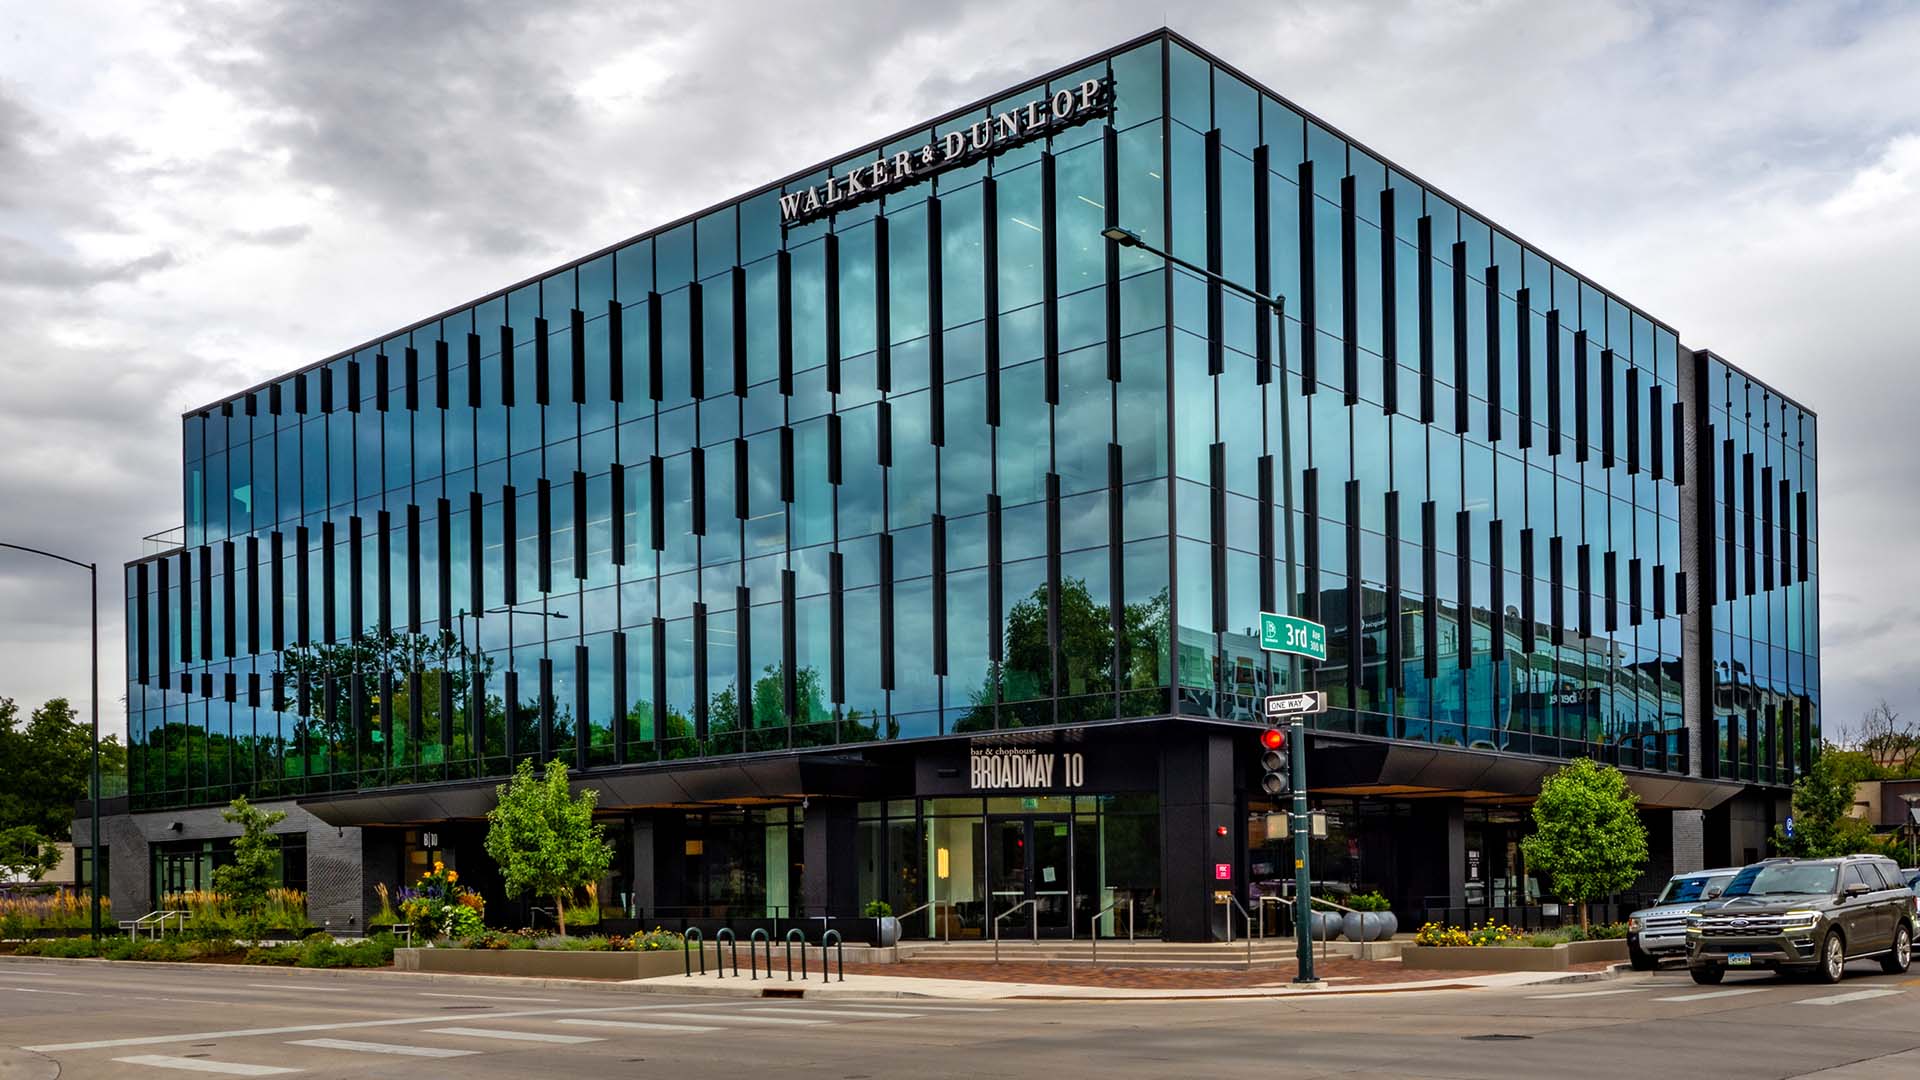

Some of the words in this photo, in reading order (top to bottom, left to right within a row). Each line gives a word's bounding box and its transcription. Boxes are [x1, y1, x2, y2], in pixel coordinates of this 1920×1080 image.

[778, 150, 912, 220] WALKER
[921, 144, 935, 164] &
[944, 78, 1101, 162] DUNLOP
[1285, 623, 1307, 648] 3rd
[1271, 702, 1285, 710] ONE
[1288, 700, 1303, 708] WAY
[970, 747, 983, 756] bar
[985, 748, 993, 756] &
[995, 747, 1036, 757] chophouse
[970, 753, 1055, 789] BROADWAY
[1063, 753, 1084, 788] 10
